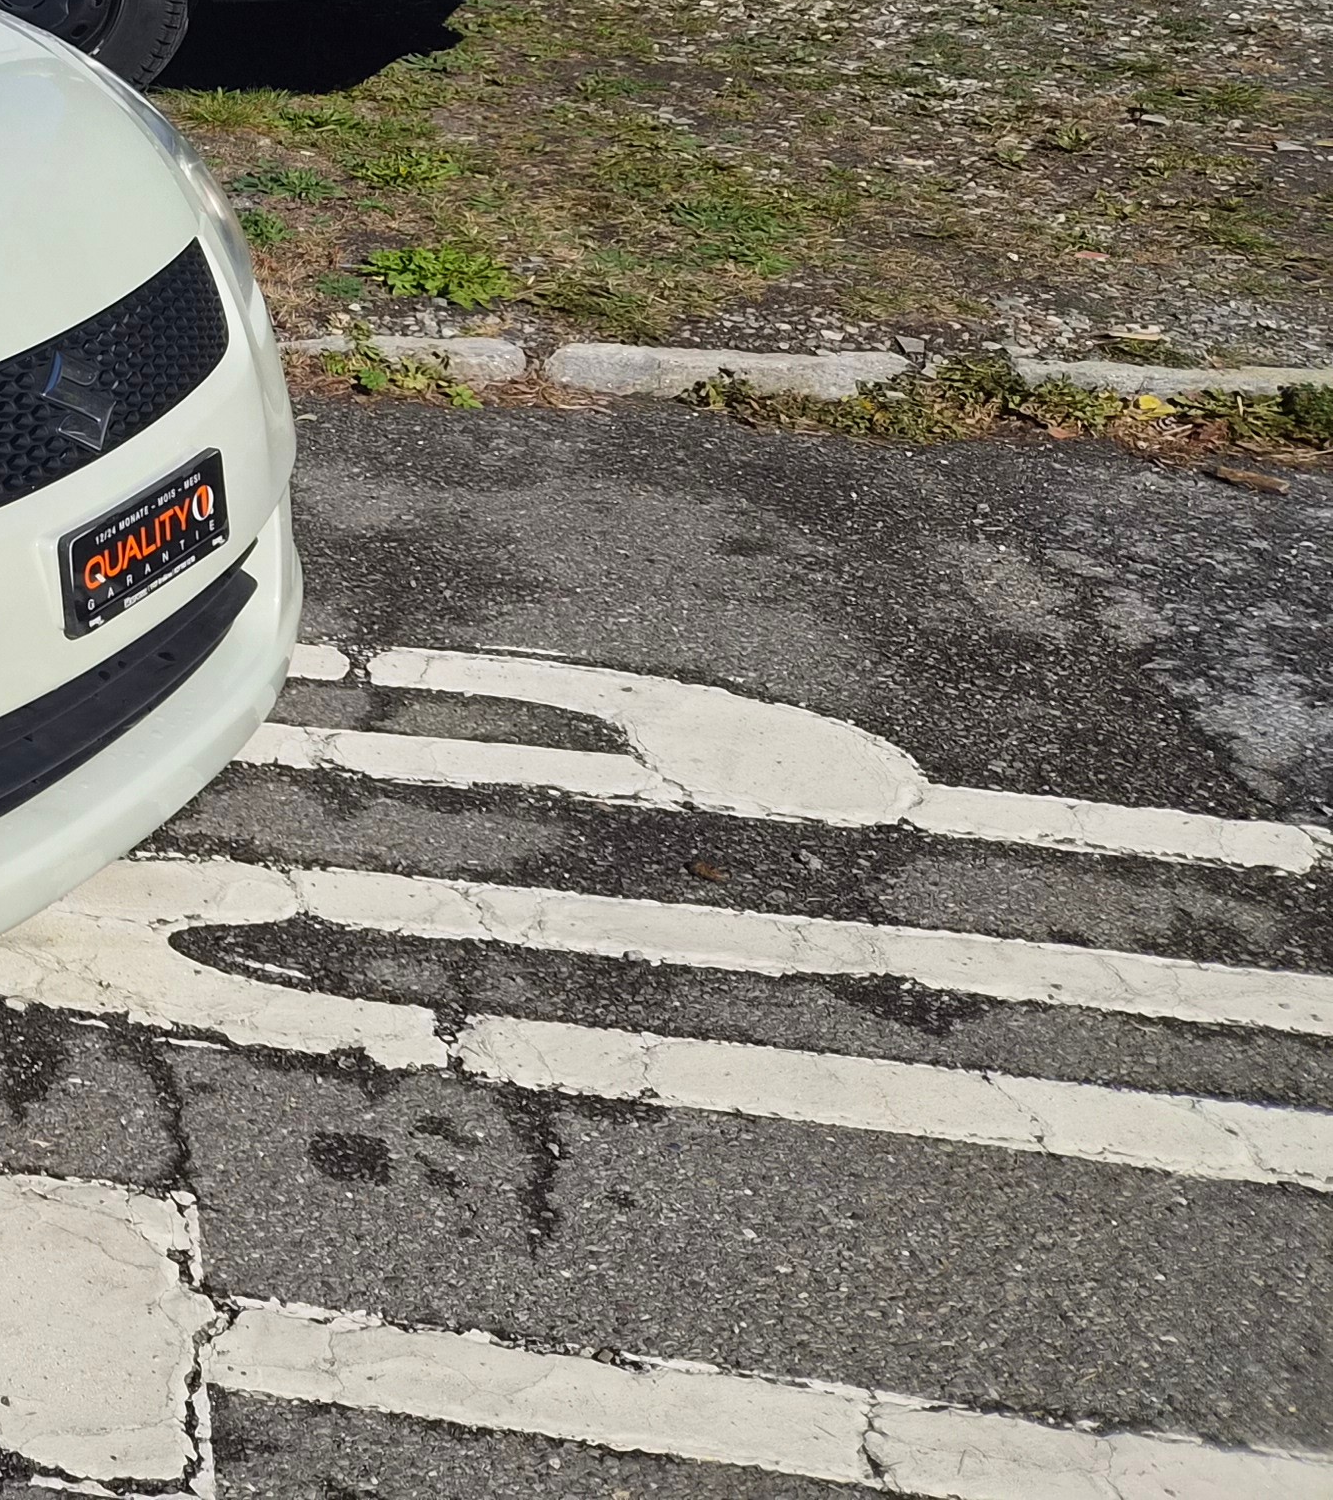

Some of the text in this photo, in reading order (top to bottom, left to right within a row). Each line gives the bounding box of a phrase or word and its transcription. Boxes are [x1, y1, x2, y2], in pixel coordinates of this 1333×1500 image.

[95, 525, 117, 545] 12/24
[119, 505, 149, 531] MONATE
[157, 488, 176, 505] MOIS
[184, 472, 201, 490] MESI
[87, 519, 215, 611] GARANTIE
